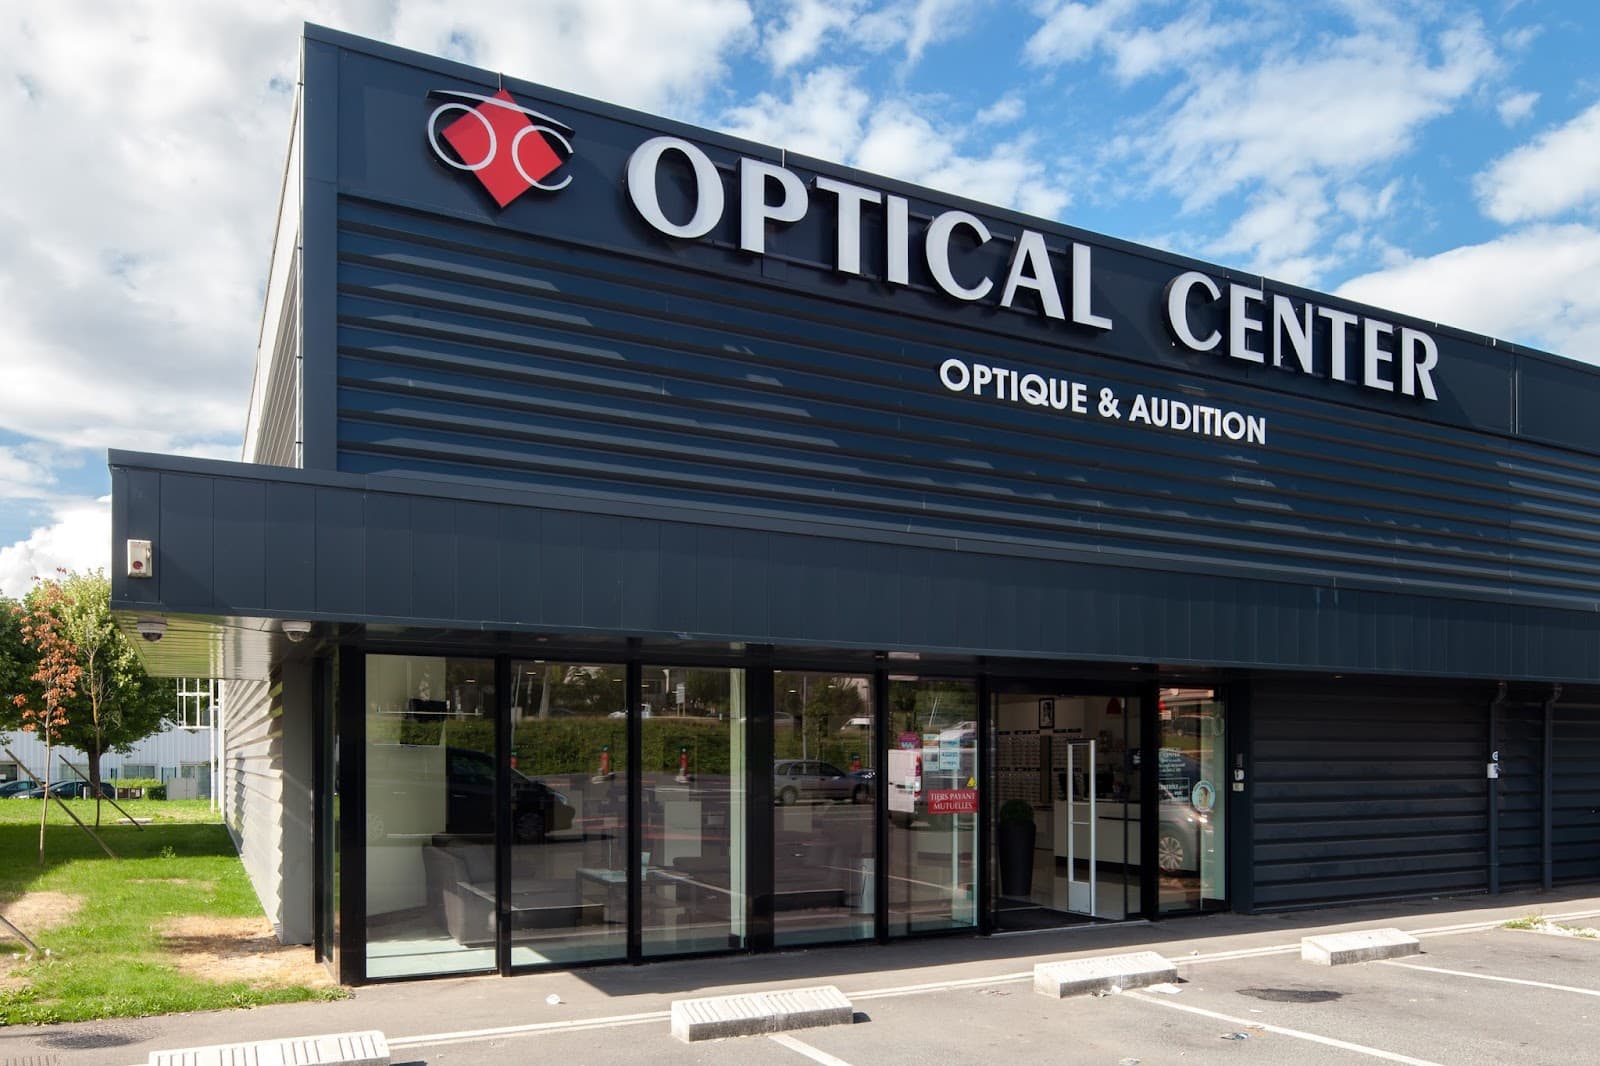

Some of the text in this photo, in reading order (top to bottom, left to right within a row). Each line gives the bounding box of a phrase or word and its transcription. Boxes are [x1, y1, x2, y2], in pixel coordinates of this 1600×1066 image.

[626, 135, 1439, 401] OPTICAL CENTER
[938, 358, 1266, 446] OPTIQUE & AUDITION
[930, 792, 976, 801] TIERS PAYANT
[933, 802, 974, 810] MUTUELLES
